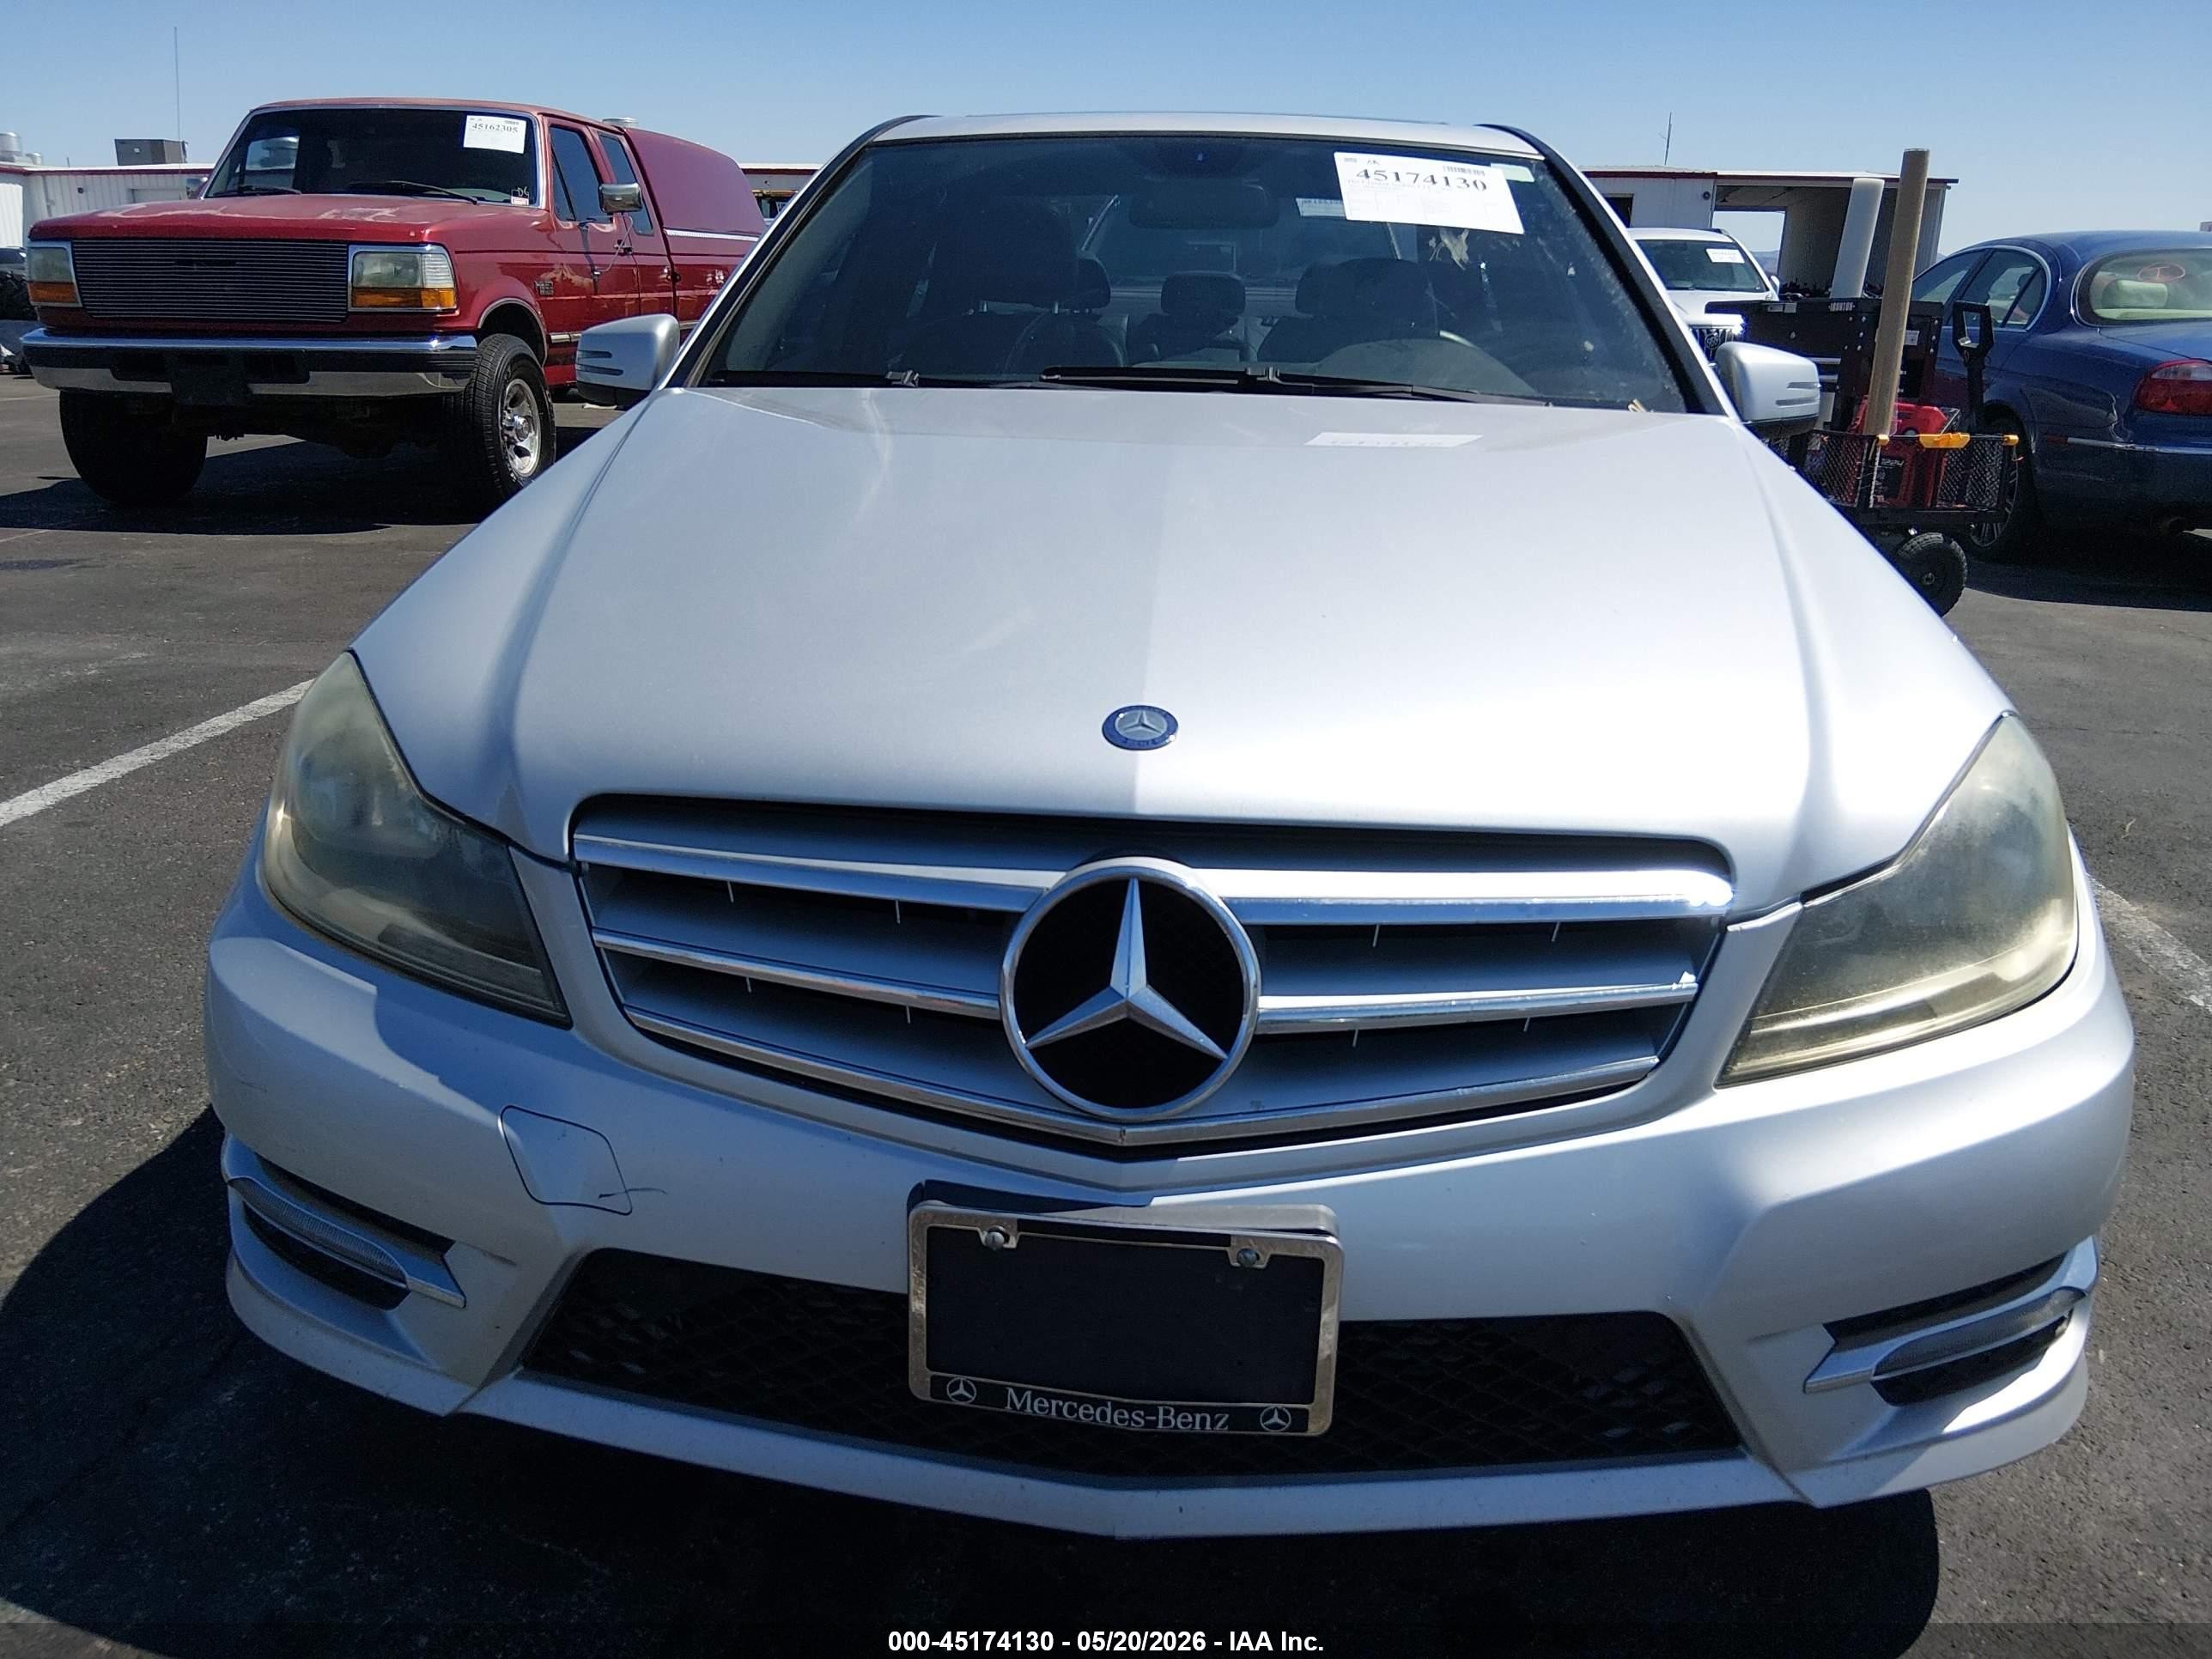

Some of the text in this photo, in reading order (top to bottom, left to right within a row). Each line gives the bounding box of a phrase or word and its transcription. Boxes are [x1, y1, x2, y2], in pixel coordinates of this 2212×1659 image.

[472, 123, 519, 133] 45162305
[1356, 168, 1487, 192] 45174130
[1005, 1387, 1230, 1431] Mercedes-Benz
